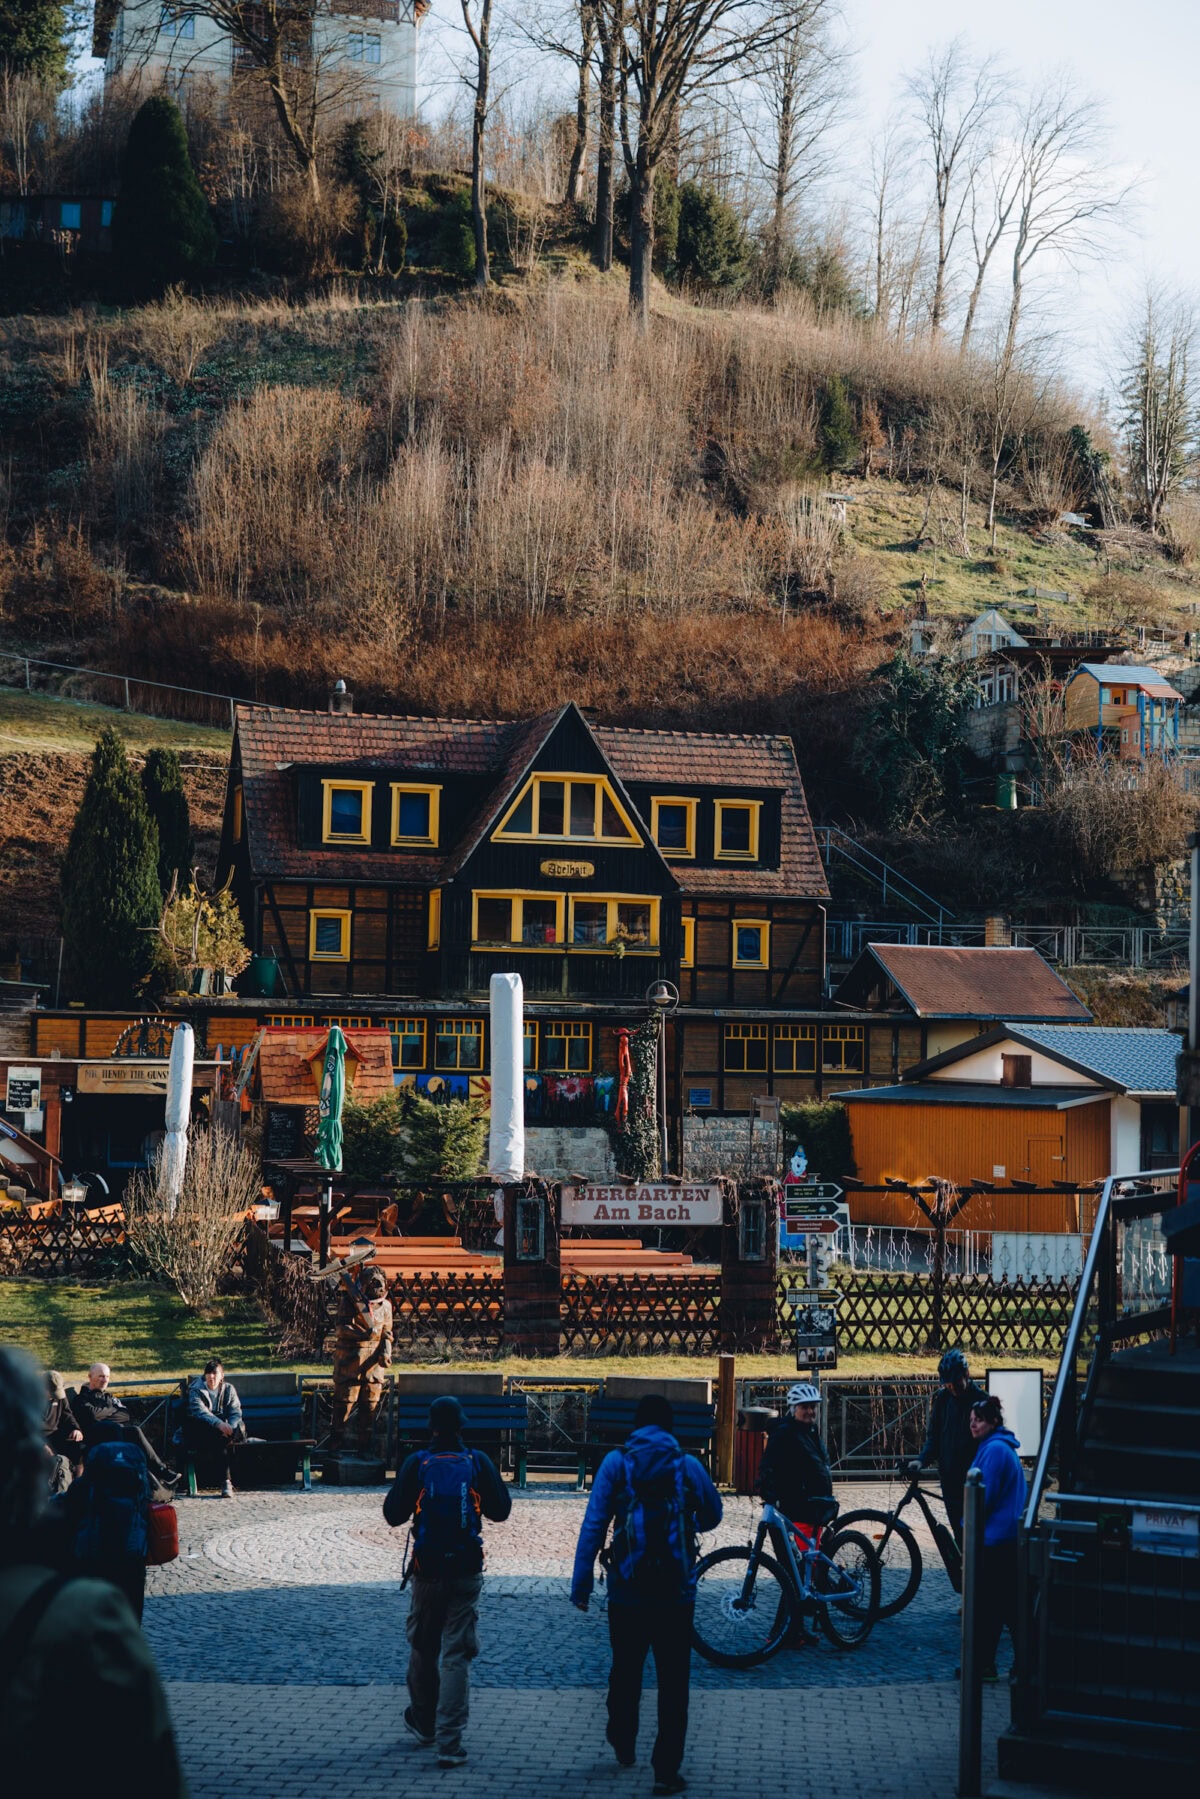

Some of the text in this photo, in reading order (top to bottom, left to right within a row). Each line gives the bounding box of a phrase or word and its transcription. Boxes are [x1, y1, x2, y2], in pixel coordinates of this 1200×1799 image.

[102, 1069, 128, 1079] HENRY
[130, 1070, 145, 1079] THE
[573, 1188, 710, 1202] BIERGARTEN
[593, 1204, 691, 1221] Am Bach
[1145, 1511, 1187, 1528] PRIVAT
